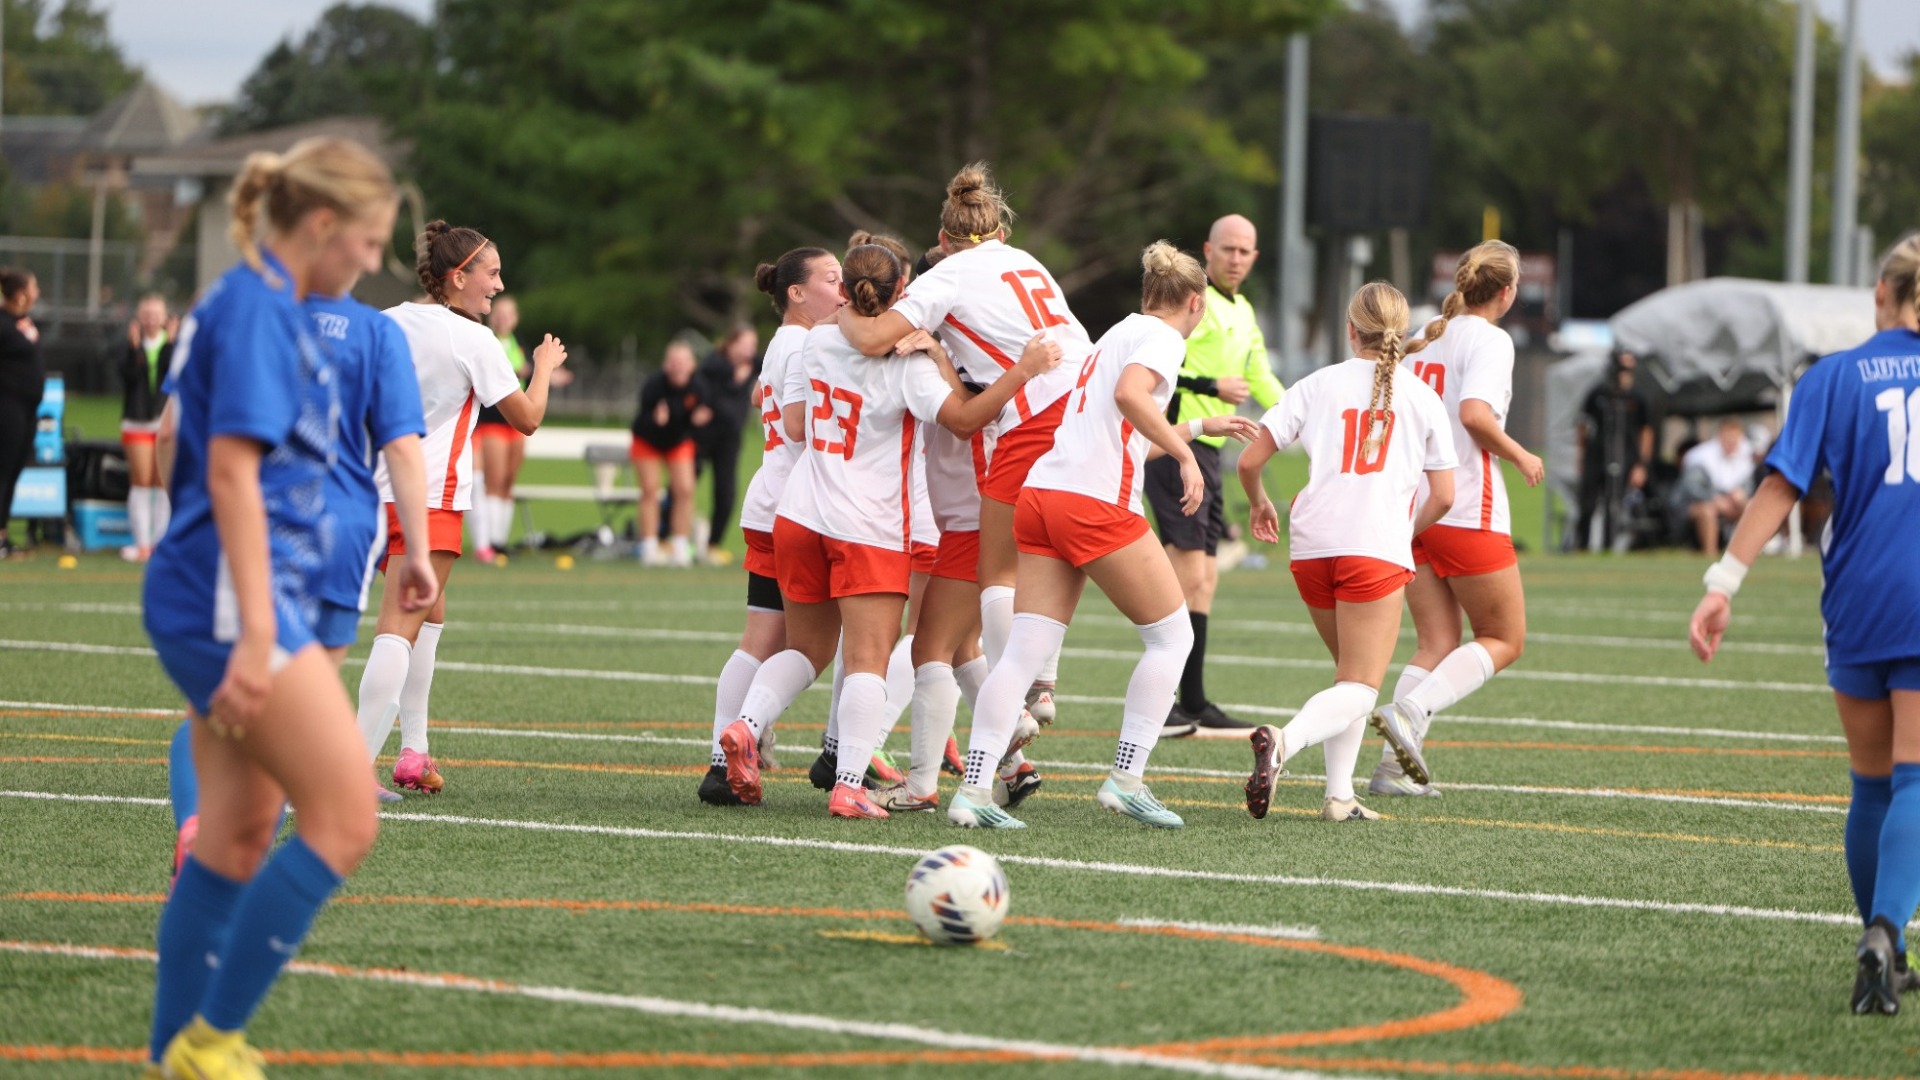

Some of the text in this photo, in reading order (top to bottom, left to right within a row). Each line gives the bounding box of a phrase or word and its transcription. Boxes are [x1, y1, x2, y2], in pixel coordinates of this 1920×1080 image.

[1000, 269, 1070, 330] 12
[809, 378, 863, 461] 23
[1340, 408, 1395, 475] 10
